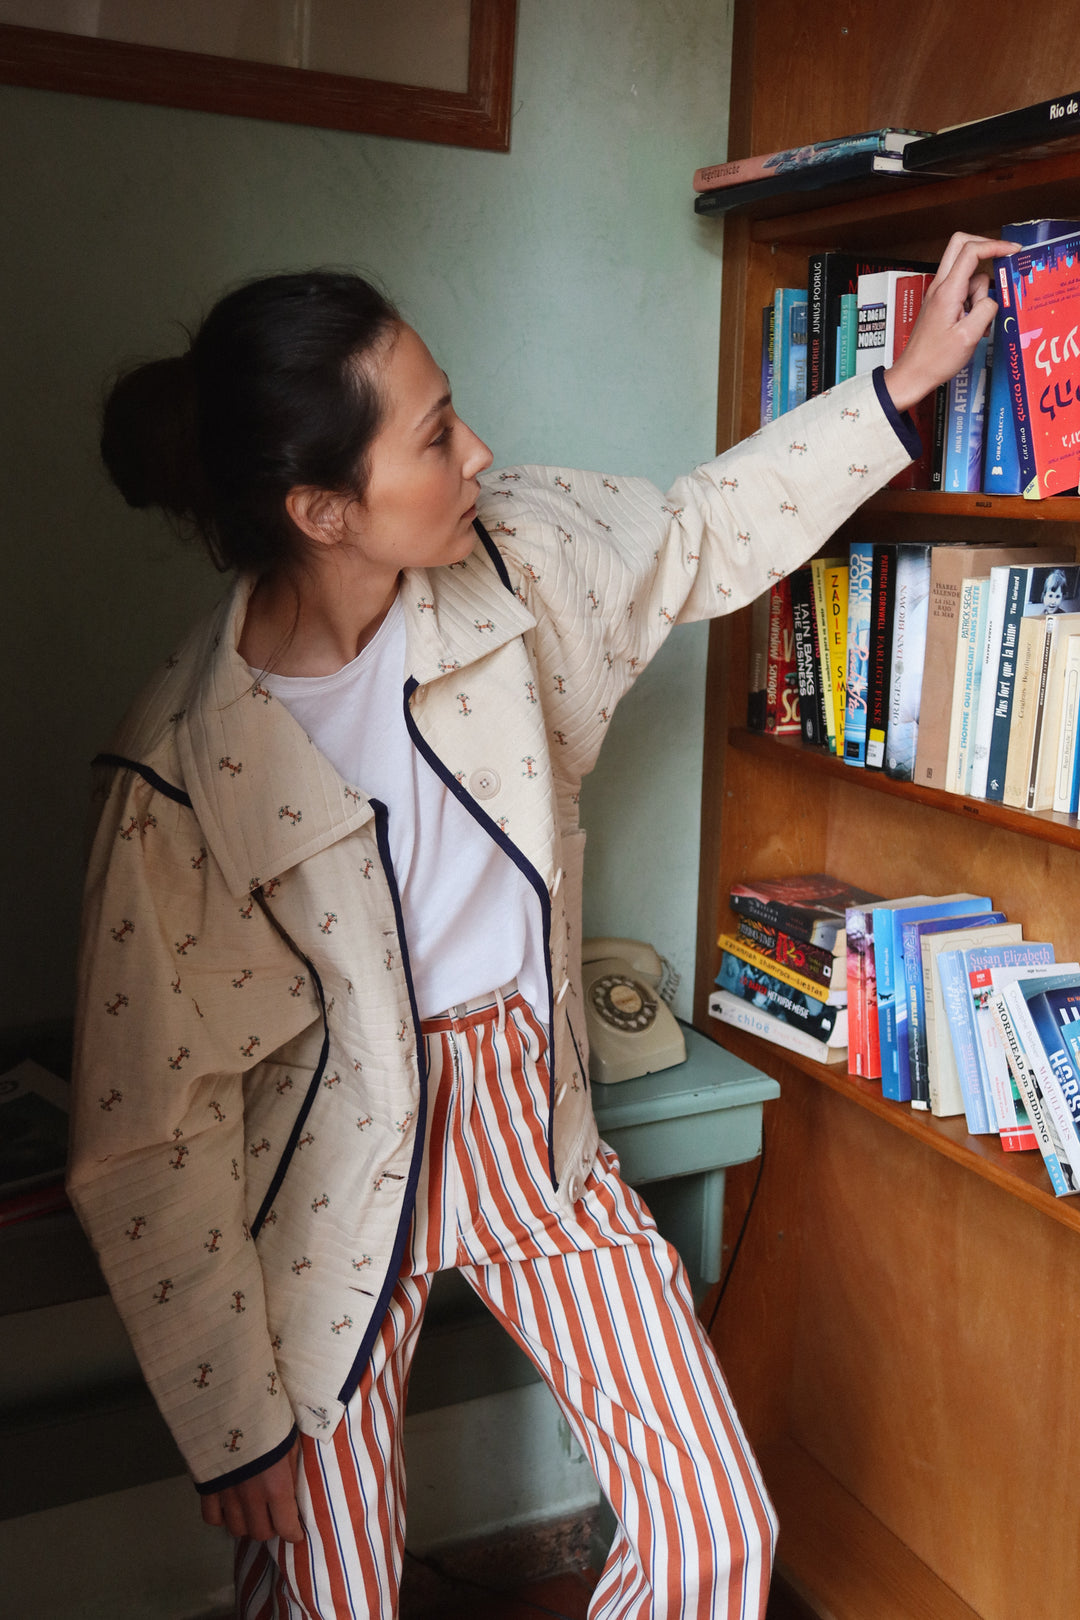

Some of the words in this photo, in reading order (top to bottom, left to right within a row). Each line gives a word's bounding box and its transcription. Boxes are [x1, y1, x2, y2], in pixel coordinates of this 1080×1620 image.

[1066, 99, 1079, 115] de
[813, 262, 822, 300] PODRUG
[812, 302, 821, 334] JUNIUS
[858, 309, 867, 323] DE
[867, 308, 879, 322] DAG
[858, 331, 886, 348] MORGEN
[811, 338, 820, 391] MEURTRIER
[1009, 342, 1021, 381] לנעליה
[766, 376, 774, 398] New
[954, 368, 969, 414] AFTER
[1013, 383, 1026, 422] להיכנס
[880, 554, 889, 589] PATRICIA
[932, 589, 960, 598] ALLENDE
[935, 583, 958, 591] ISABEL
[963, 586, 973, 610] SEGAL
[771, 595, 781, 615] don
[793, 604, 802, 629] THE
[831, 574, 842, 645] ZADIE
[877, 591, 887, 630] CORNWELL
[898, 585, 907, 631] BROWN
[971, 606, 979, 618] SA
[1010, 602, 1018, 615] Tim
[801, 603, 811, 637] IAIN
[961, 610, 970, 639] PATRICK
[969, 619, 978, 643] DANS
[769, 617, 781, 659] winslow
[896, 634, 904, 659] DAN
[1003, 623, 1017, 648] haine
[796, 632, 807, 697] BUSINESS
[875, 635, 886, 684] FARLIGT
[1002, 648, 1014, 659] la
[803, 643, 815, 696] BANKS
[966, 646, 976, 691] MARCHAIT
[1003, 661, 1014, 678] que
[767, 663, 778, 705] savages
[998, 681, 1011, 699] fort
[873, 690, 883, 725] FISKE
[892, 675, 902, 726] ORIGEN
[963, 691, 971, 708] QUI
[995, 699, 1009, 718] Plus
[970, 952, 1001, 966] Susan
[1003, 947, 1050, 965] Elizabeth
[737, 1012, 770, 1034] chloë
[910, 1002, 919, 1027] BULLET
[996, 1001, 1025, 1071] MOREHEAD
[1020, 1074, 1028, 1088] on
[1027, 1091, 1049, 1144] BIDDING
[1039, 1065, 1072, 1142] MAQUILLAGES
[1048, 1158, 1065, 1193] FABER
